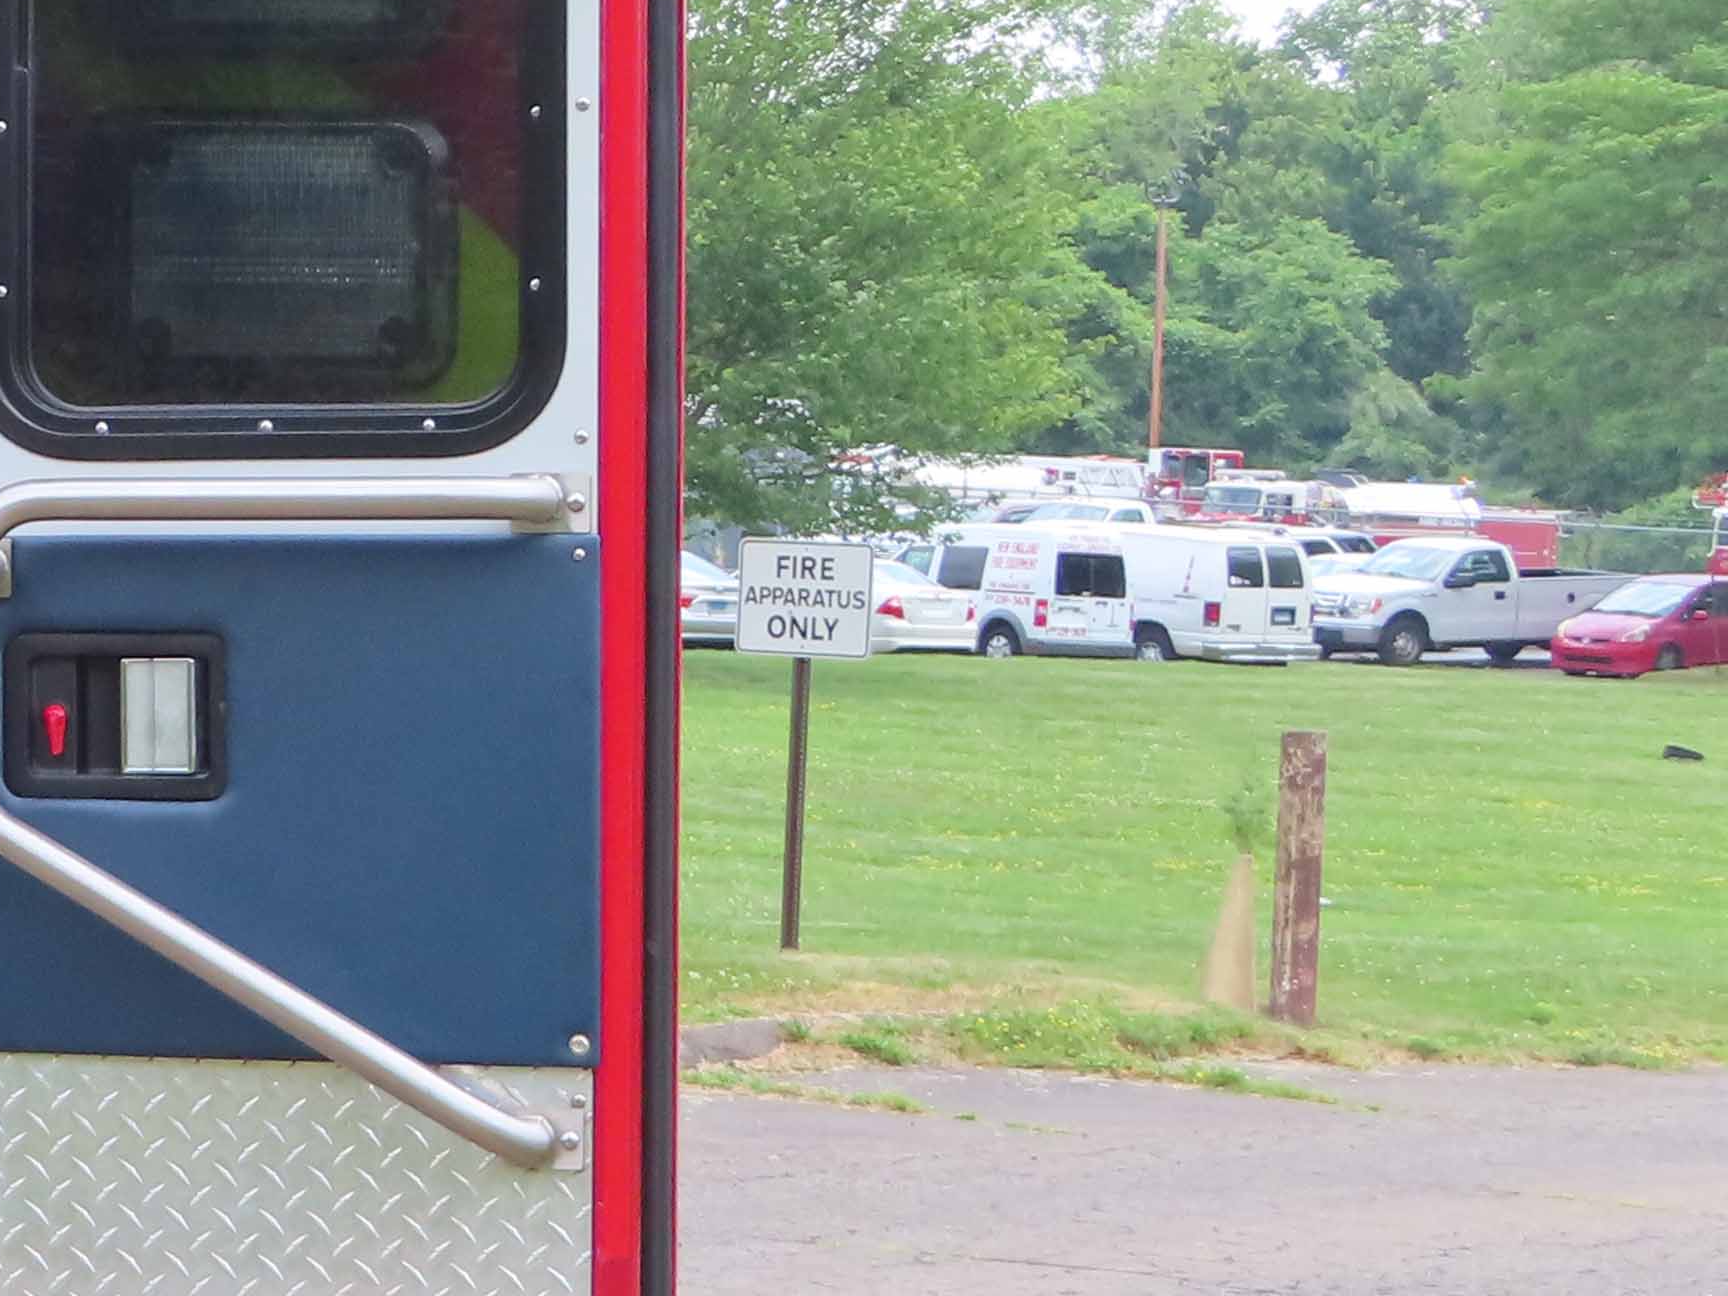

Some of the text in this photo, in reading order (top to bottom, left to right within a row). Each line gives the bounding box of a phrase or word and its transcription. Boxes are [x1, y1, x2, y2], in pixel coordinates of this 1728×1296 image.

[776, 555, 835, 580] FIRE
[745, 585, 866, 610] APPARATUS
[767, 614, 839, 641] ONLY
